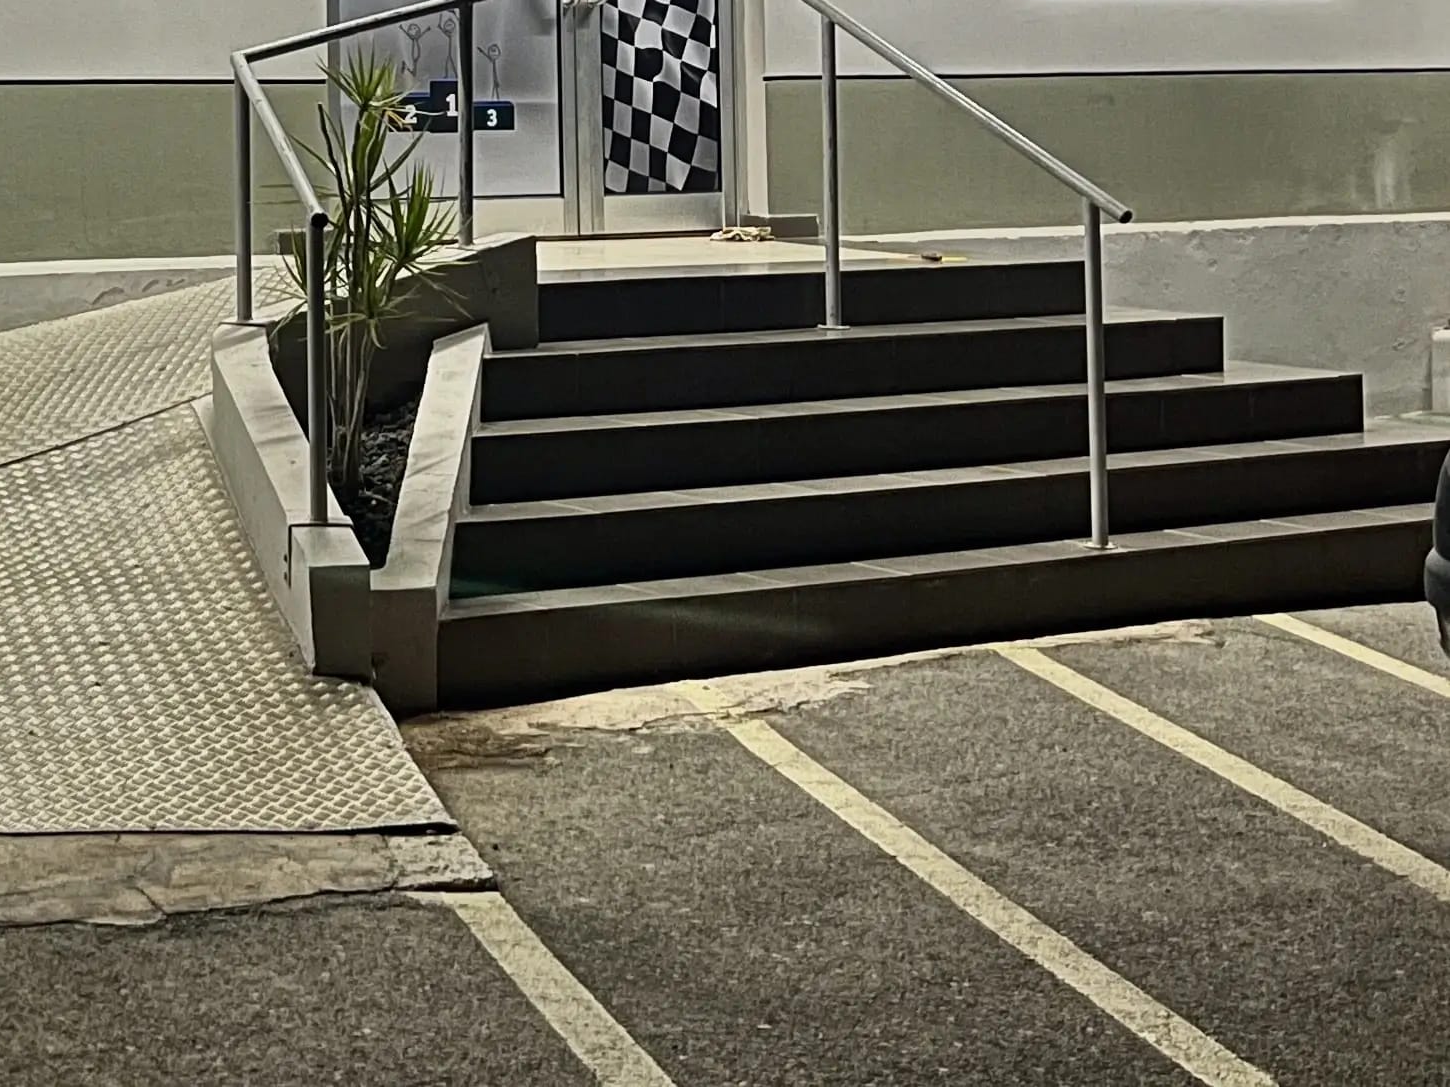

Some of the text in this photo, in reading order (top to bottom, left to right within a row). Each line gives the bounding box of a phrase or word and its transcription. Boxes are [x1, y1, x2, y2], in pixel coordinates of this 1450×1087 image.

[405, 104, 418, 124] 2
[445, 93, 459, 117] 1
[486, 108, 498, 127] 3
